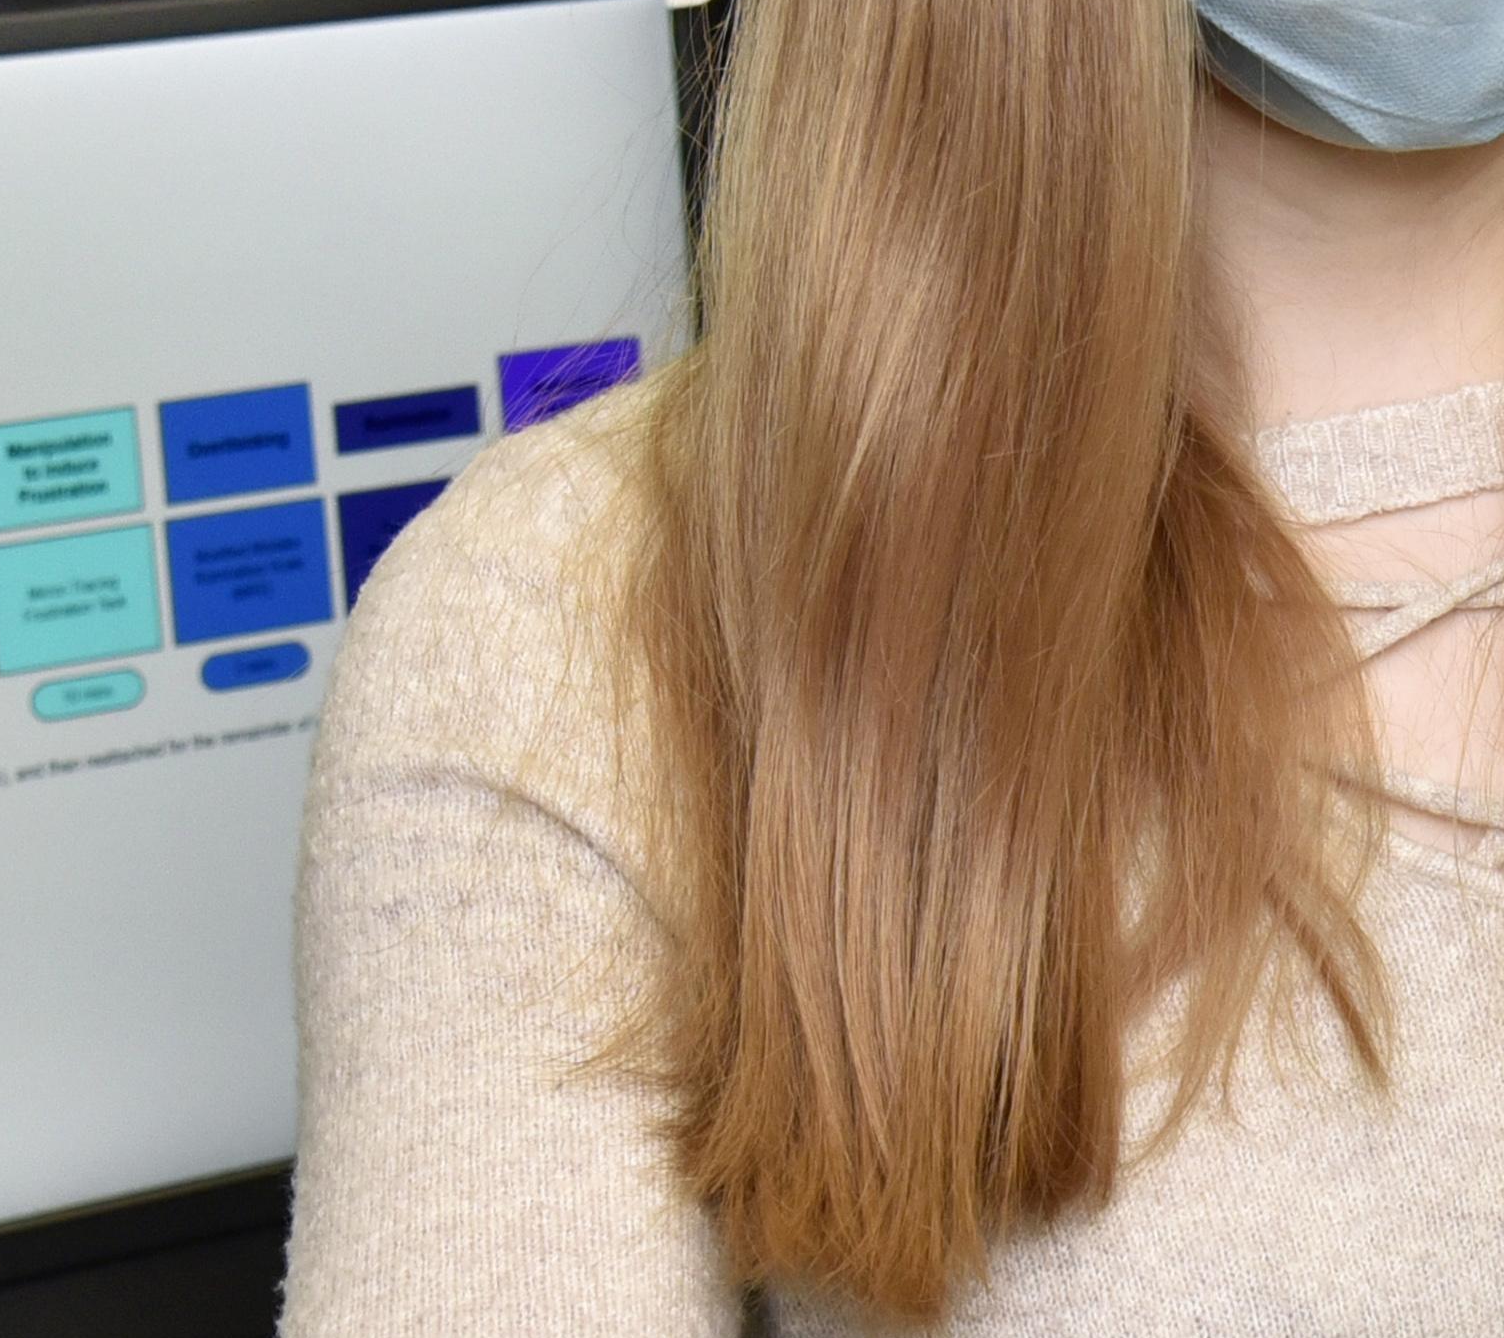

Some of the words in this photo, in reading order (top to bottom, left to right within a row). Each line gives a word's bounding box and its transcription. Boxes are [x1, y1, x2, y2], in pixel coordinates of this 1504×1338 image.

[14, 762, 47, 783] and
[48, 757, 80, 775] then
[167, 738, 189, 755] for
[191, 732, 216, 750] the
[219, 719, 292, 747] remainder
